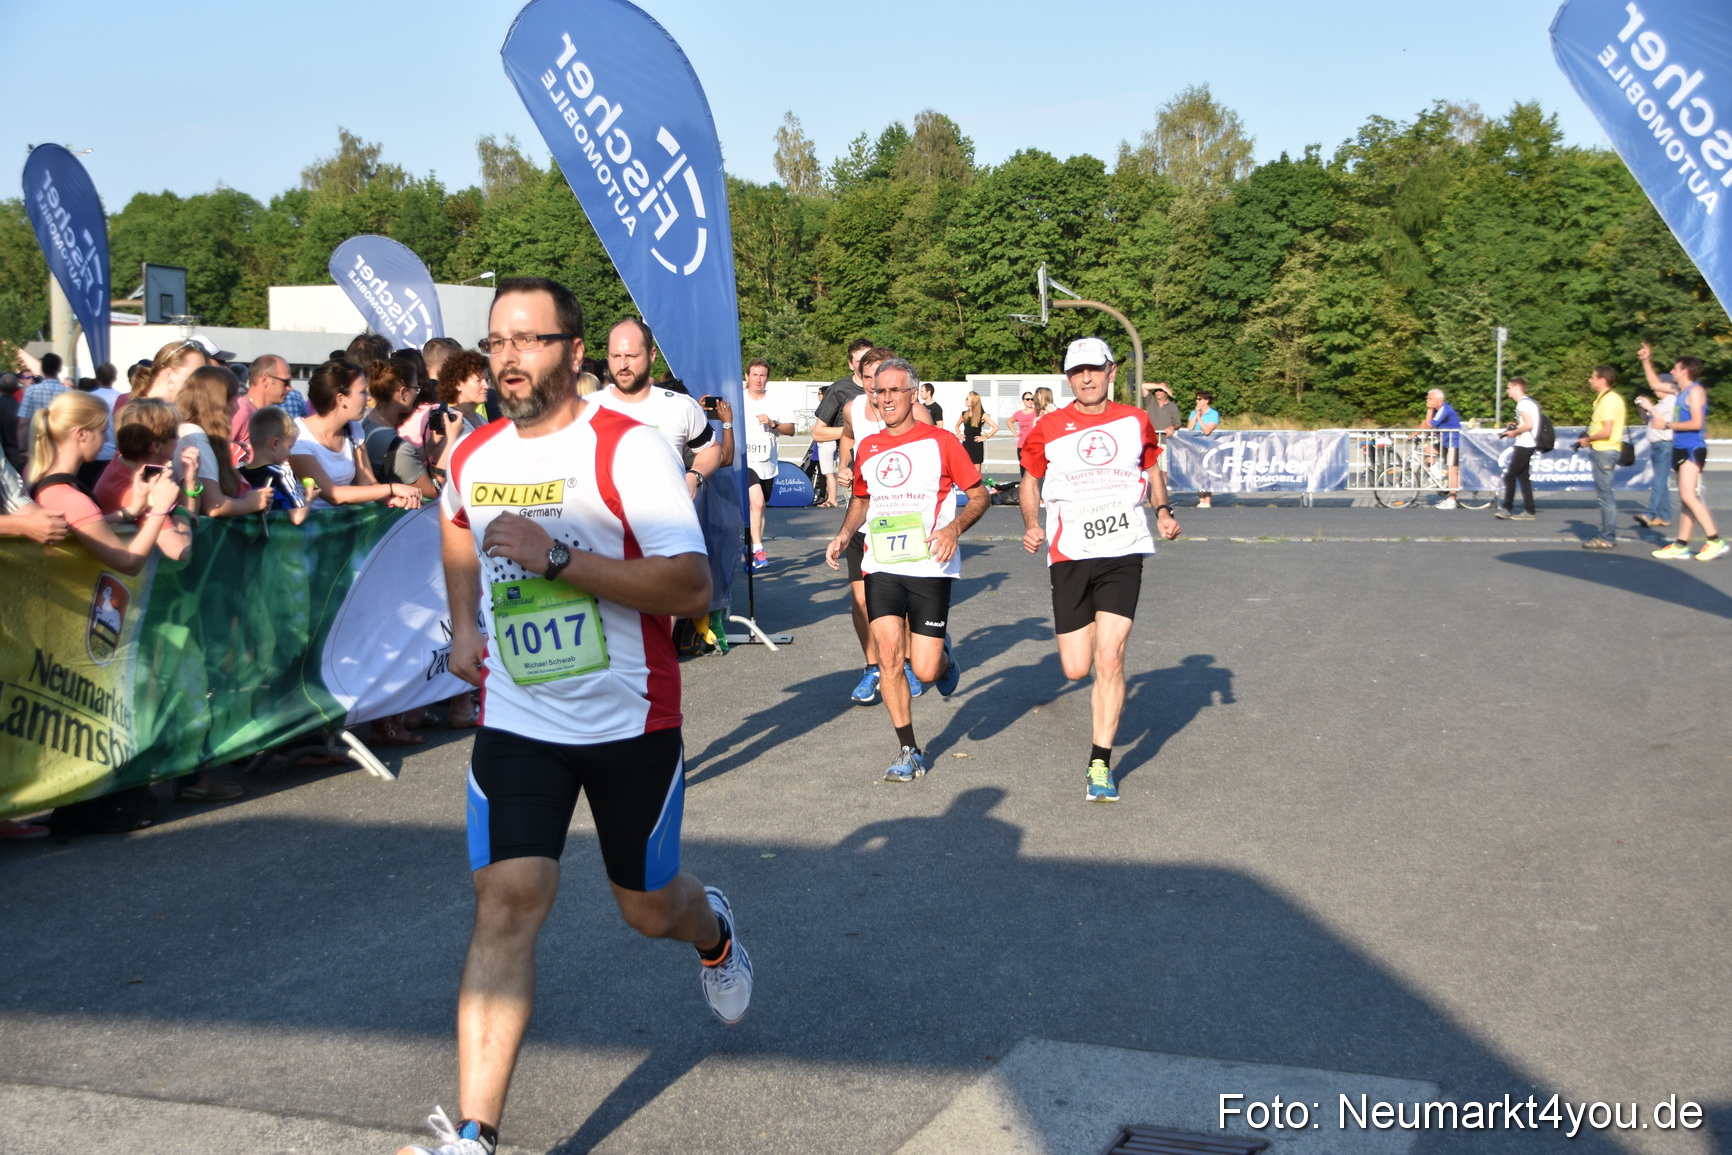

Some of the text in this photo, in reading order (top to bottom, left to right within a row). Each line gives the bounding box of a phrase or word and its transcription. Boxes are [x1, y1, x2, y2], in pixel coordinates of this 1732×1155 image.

[1230, 475, 1303, 483] AUTOMOBILE
[475, 483, 556, 503] ONLINE
[519, 507, 563, 518] Germany
[1083, 512, 1129, 539] 8924
[886, 535, 907, 551] 77
[505, 612, 586, 656] 1017
[524, 656, 576, 669] Michael Schwab
